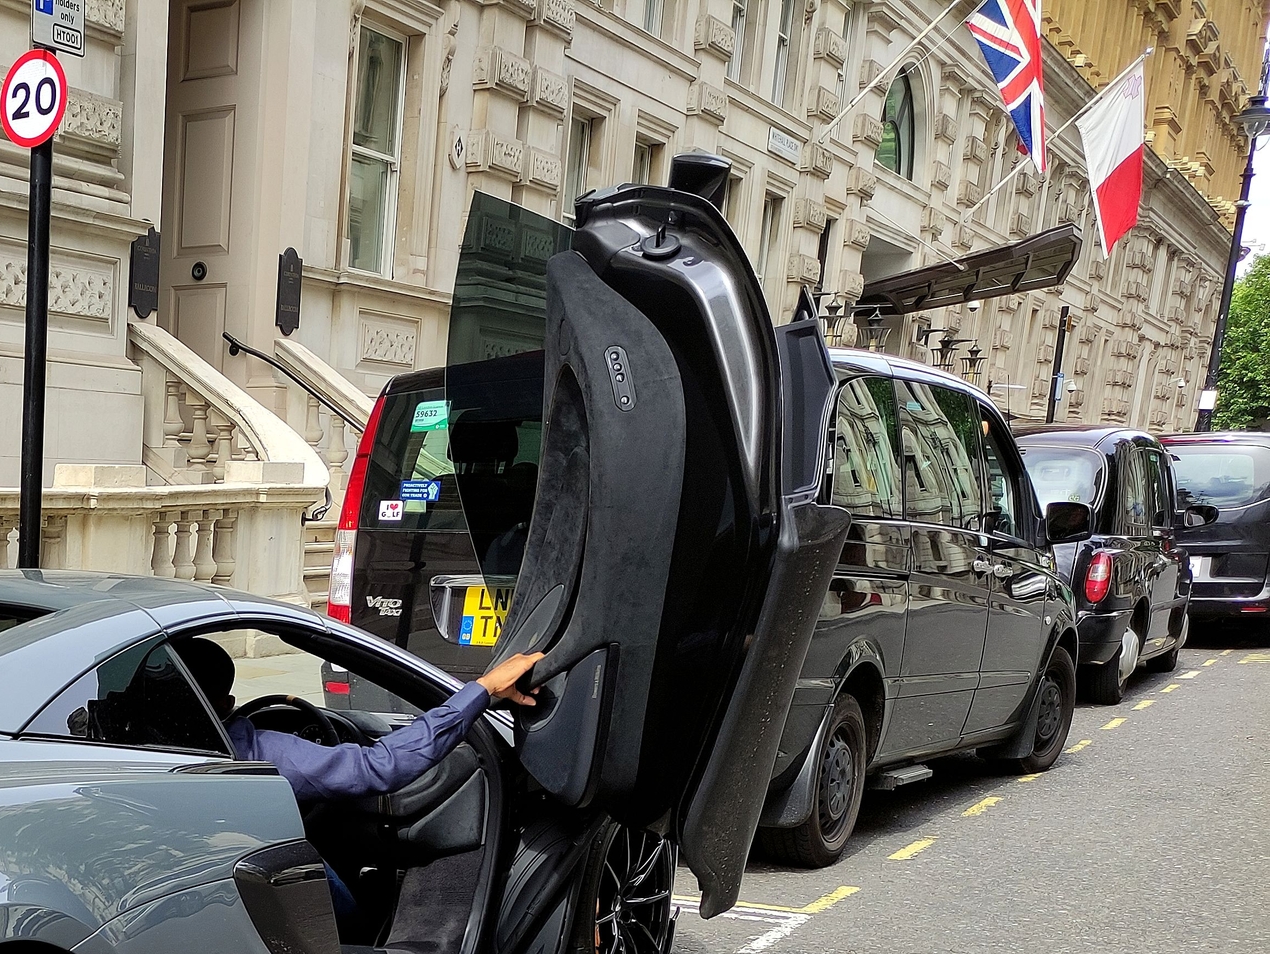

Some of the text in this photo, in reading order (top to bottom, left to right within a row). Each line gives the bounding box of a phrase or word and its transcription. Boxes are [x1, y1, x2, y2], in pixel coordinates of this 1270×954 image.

[60, 12, 75, 25] only
[56, 29, 79, 46] HT001
[11, 77, 57, 121] 20
[415, 410, 438, 418] 59632
